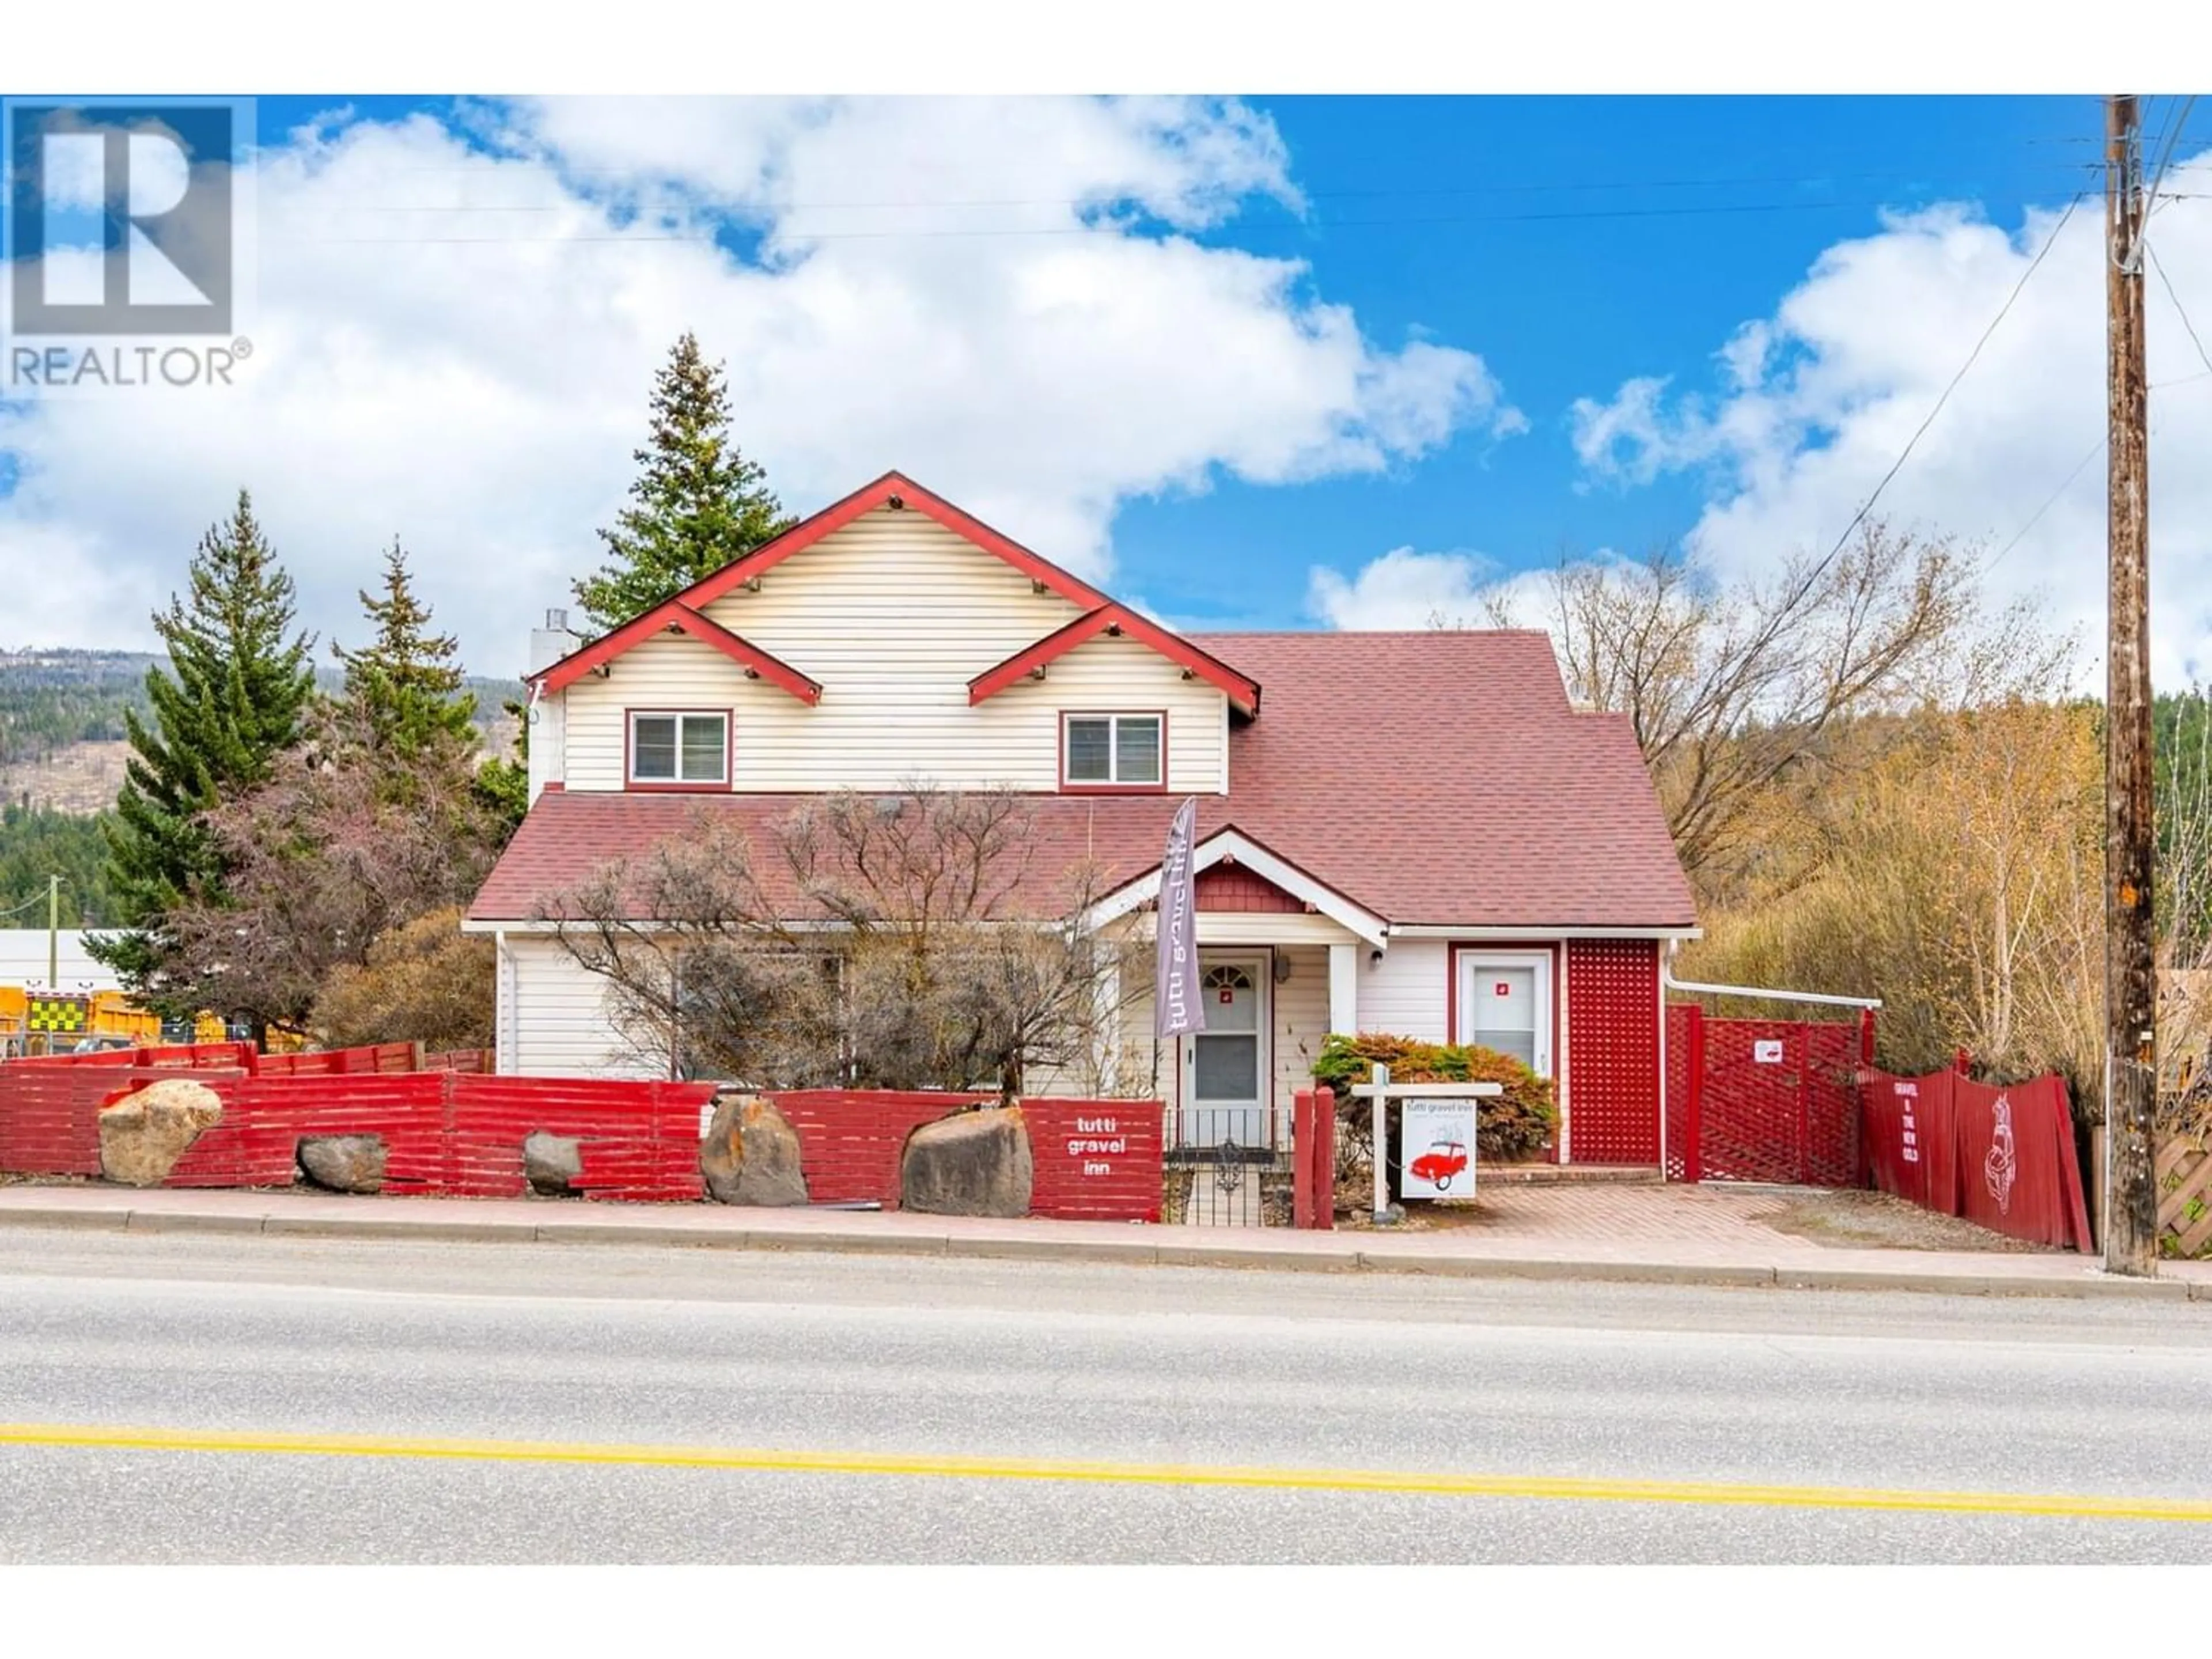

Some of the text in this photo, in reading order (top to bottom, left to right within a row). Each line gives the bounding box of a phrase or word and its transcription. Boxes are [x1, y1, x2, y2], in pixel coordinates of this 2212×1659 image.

[1169, 881, 1187, 963] gravel
[1168, 972, 1187, 1030] tutti
[1077, 1117, 1116, 1133] tutti
[1067, 1138, 1126, 1156] gravel
[1084, 1160, 1111, 1176] inn
